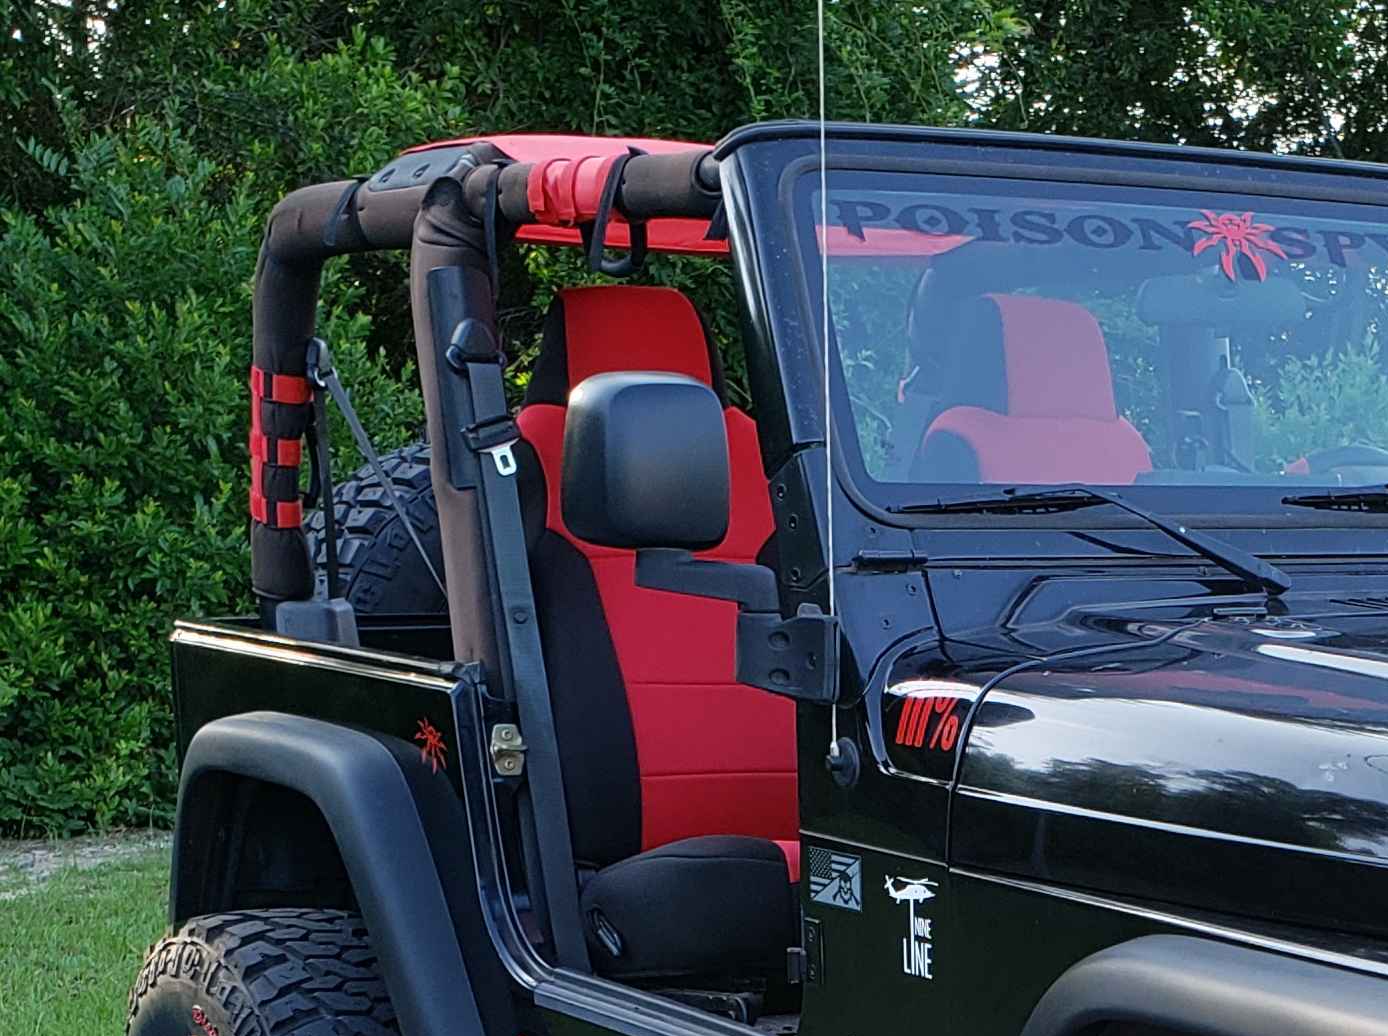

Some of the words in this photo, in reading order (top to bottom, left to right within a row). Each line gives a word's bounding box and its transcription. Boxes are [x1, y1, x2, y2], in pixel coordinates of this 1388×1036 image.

[828, 199, 1198, 257] POISON
[914, 916, 932, 939] NINE
[902, 936, 933, 980] LINE
